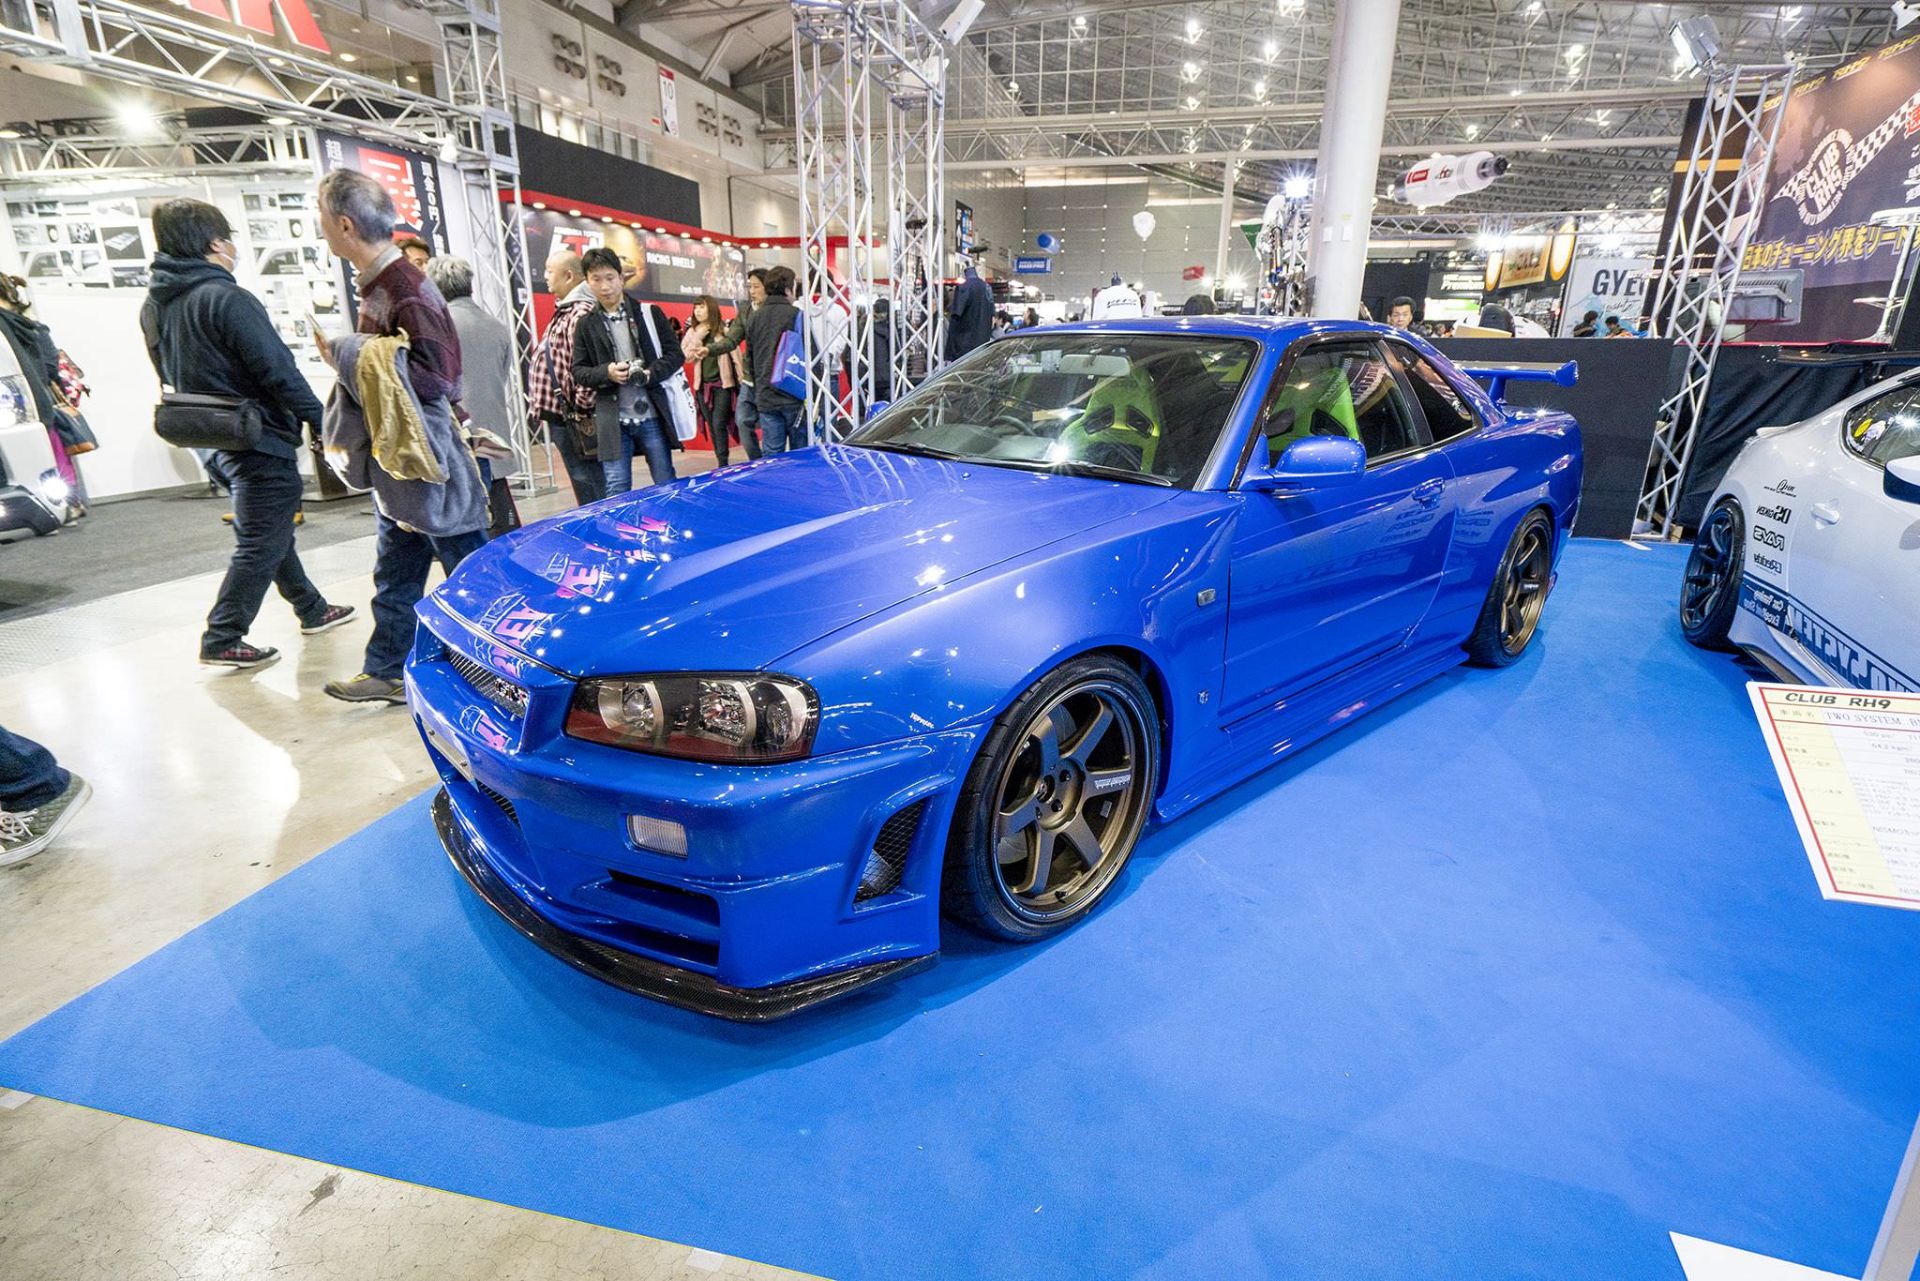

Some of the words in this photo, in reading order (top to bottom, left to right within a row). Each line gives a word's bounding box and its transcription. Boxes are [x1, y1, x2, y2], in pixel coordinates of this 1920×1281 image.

[1806, 141, 1841, 199] CLUB
[1785, 692, 1837, 705] CLUB
[1849, 697, 1892, 710] RH9
[1824, 711, 1851, 722] TWO
[1854, 713, 1902, 726] SYSTEM
